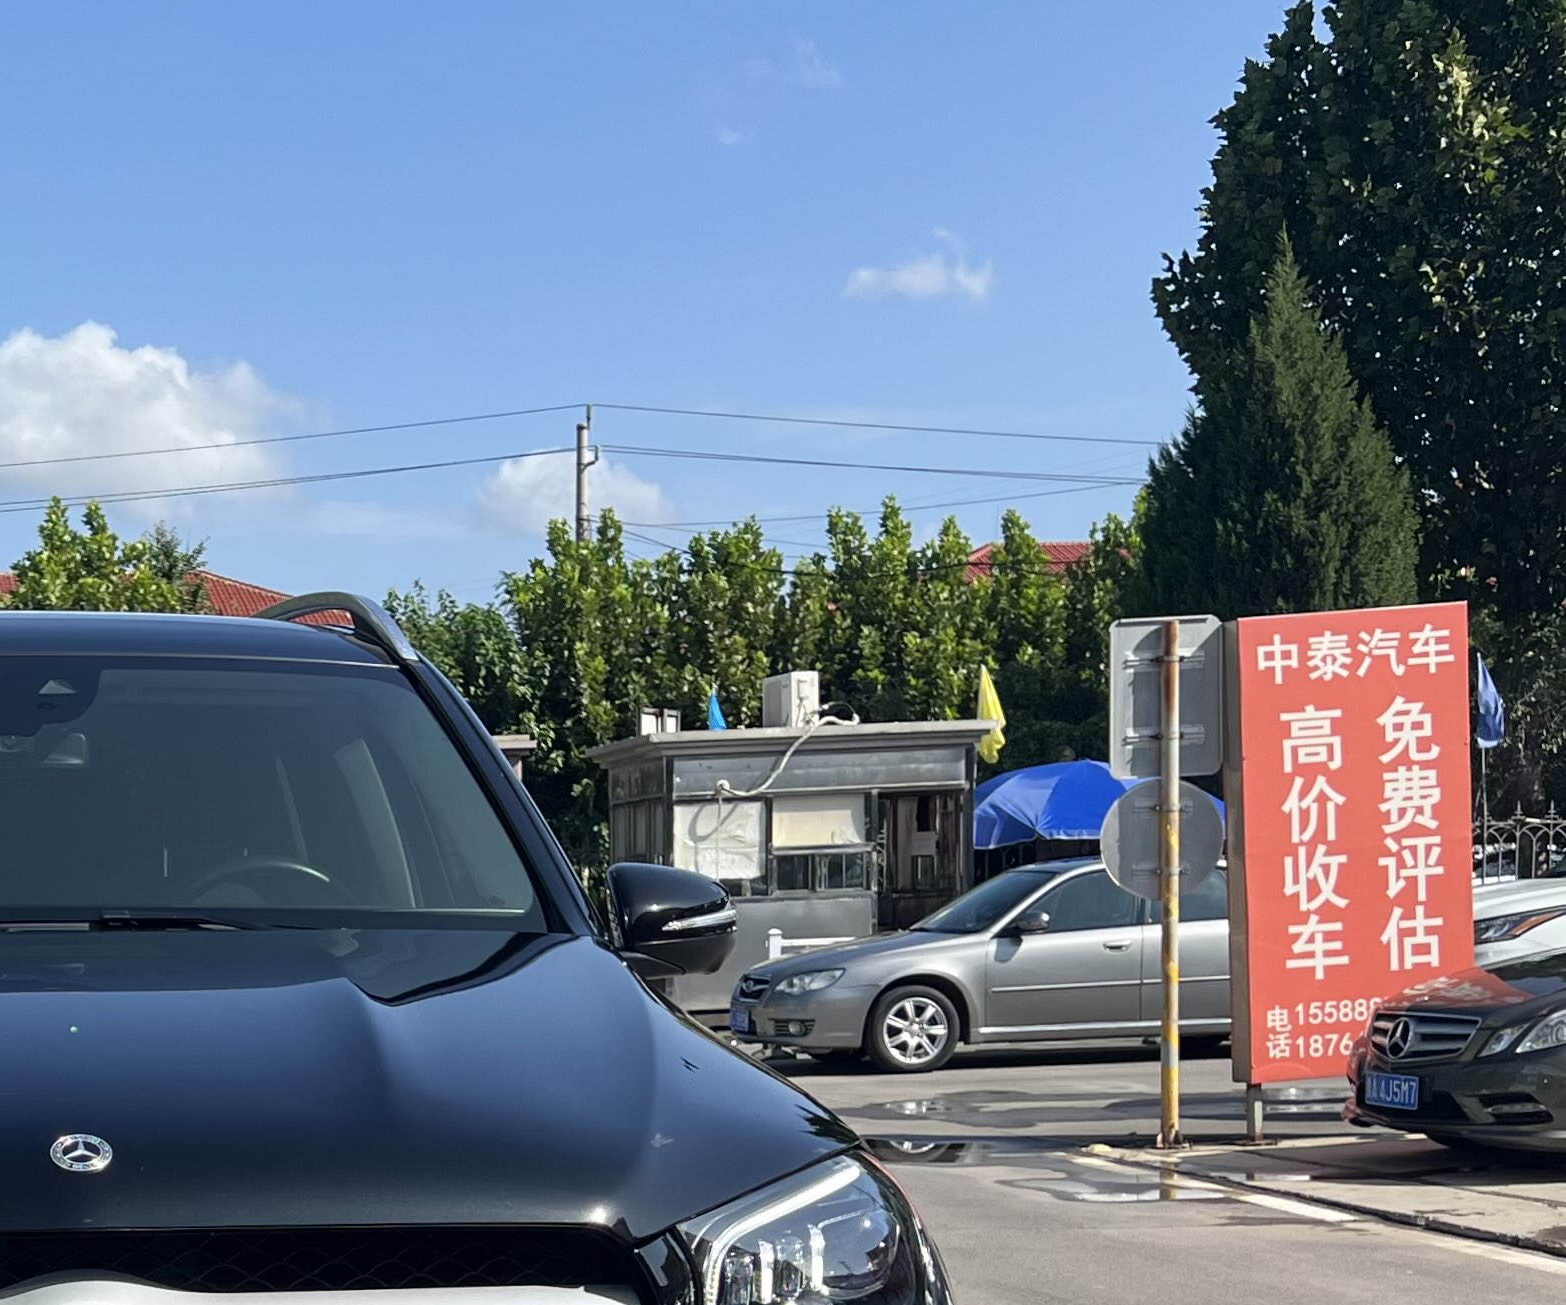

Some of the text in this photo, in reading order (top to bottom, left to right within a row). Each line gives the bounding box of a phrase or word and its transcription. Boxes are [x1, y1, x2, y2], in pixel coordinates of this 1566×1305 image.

[1256, 624, 1455, 685] 中泰汽车
[1279, 704, 1350, 980] 高价收车
[1376, 696, 1444, 971] 免费评估
